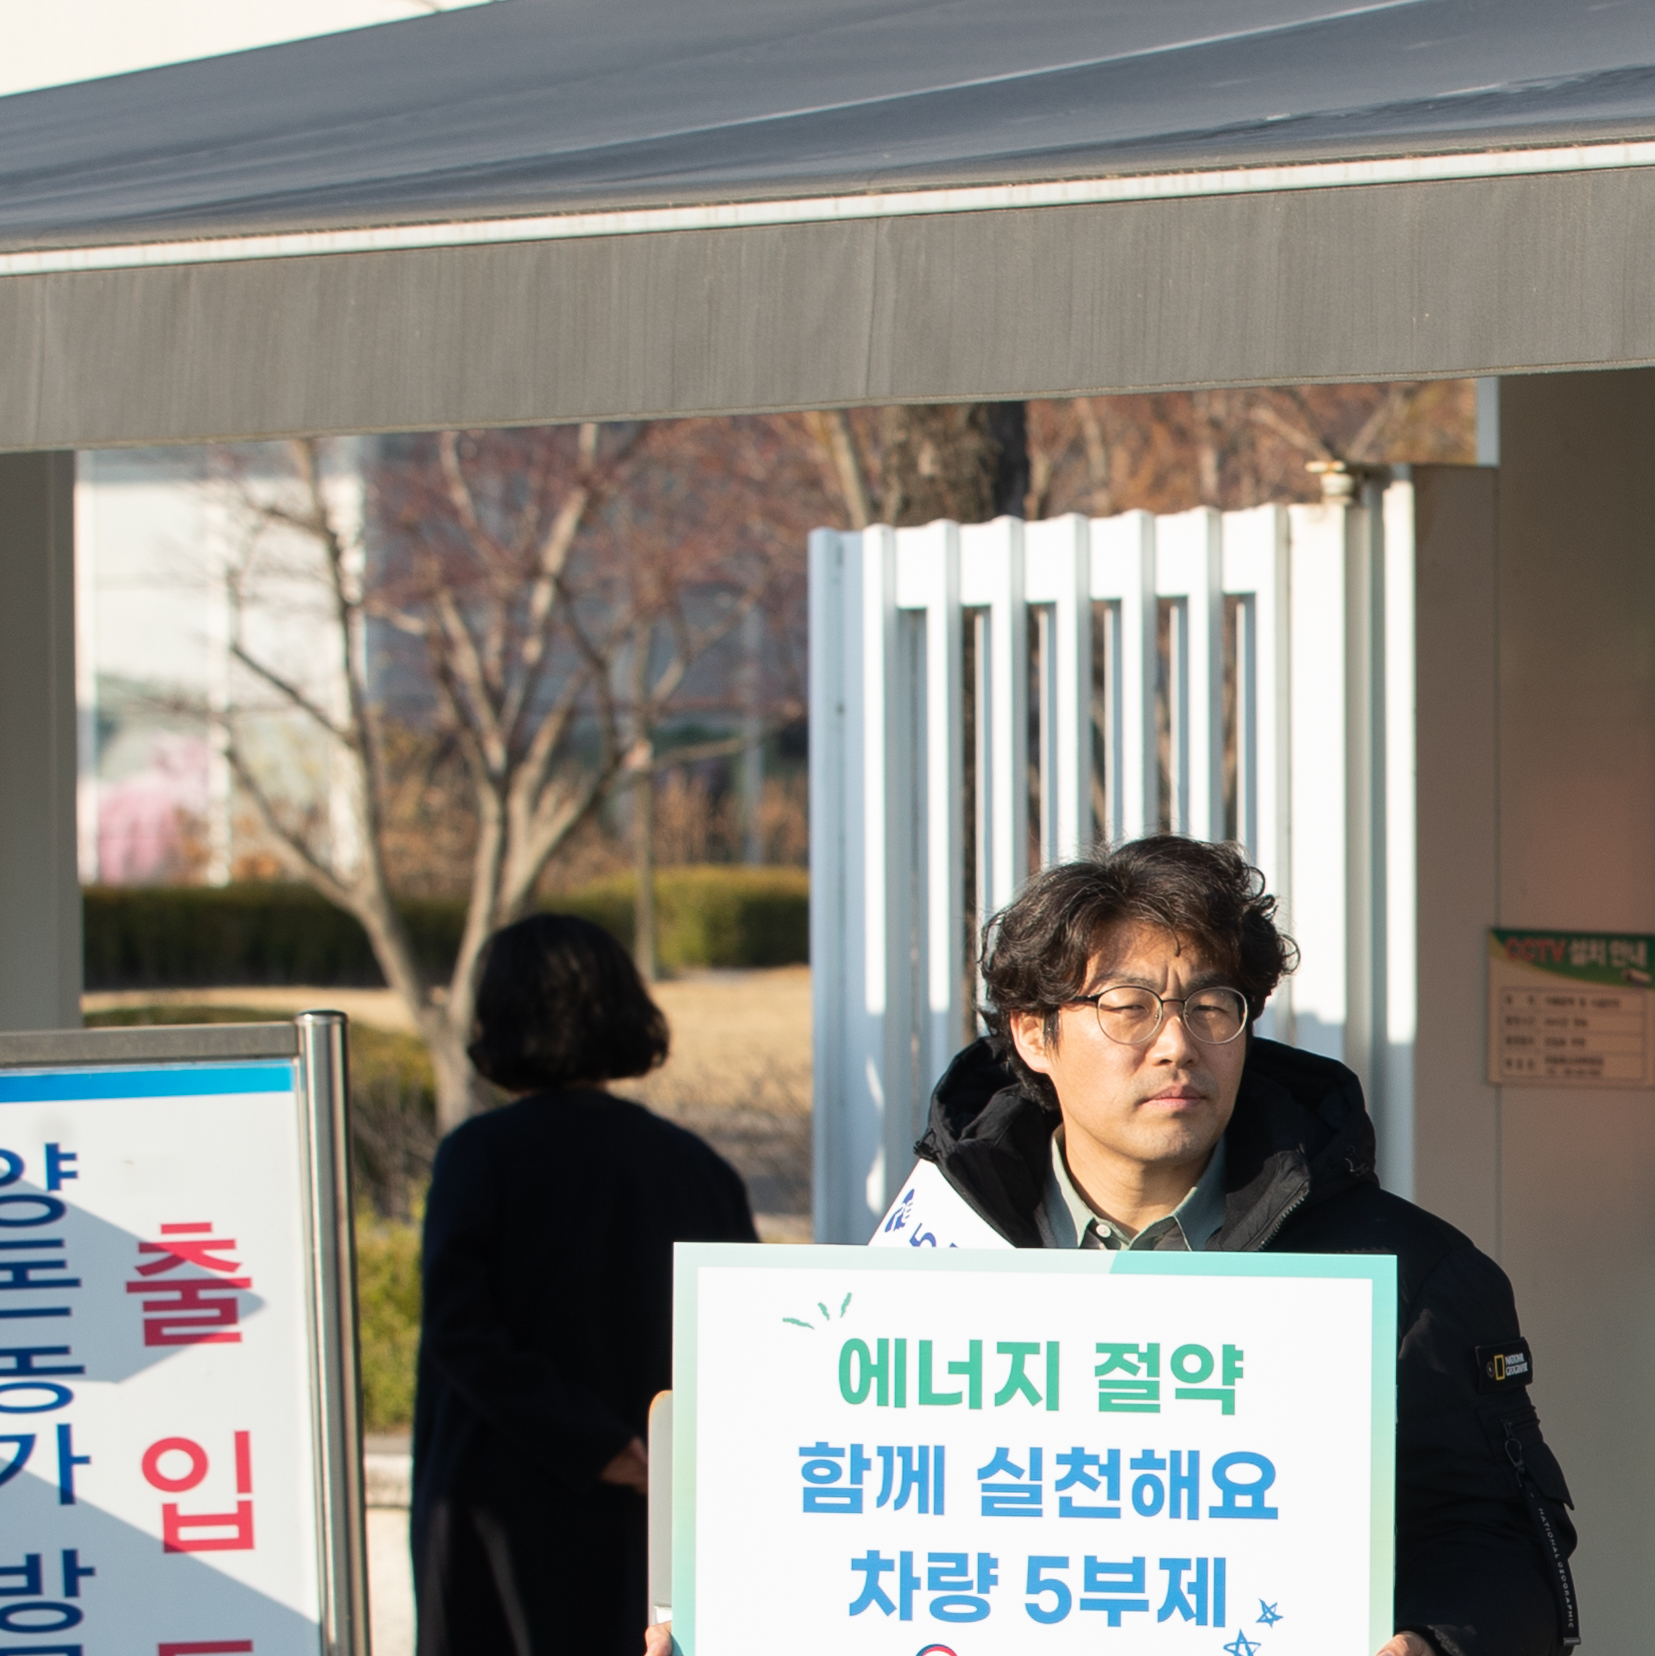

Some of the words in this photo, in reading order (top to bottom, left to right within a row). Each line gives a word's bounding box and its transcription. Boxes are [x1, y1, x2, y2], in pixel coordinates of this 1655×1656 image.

[1505, 937, 1566, 962] CCTV
[839, 1338, 1059, 1411] 에너지
[1095, 1343, 1244, 1415] 절약
[799, 1442, 945, 1516] 함께
[977, 1447, 1278, 1520] 실천해요
[849, 1550, 999, 1623] 차량
[1025, 1555, 1226, 1628] 5부제
